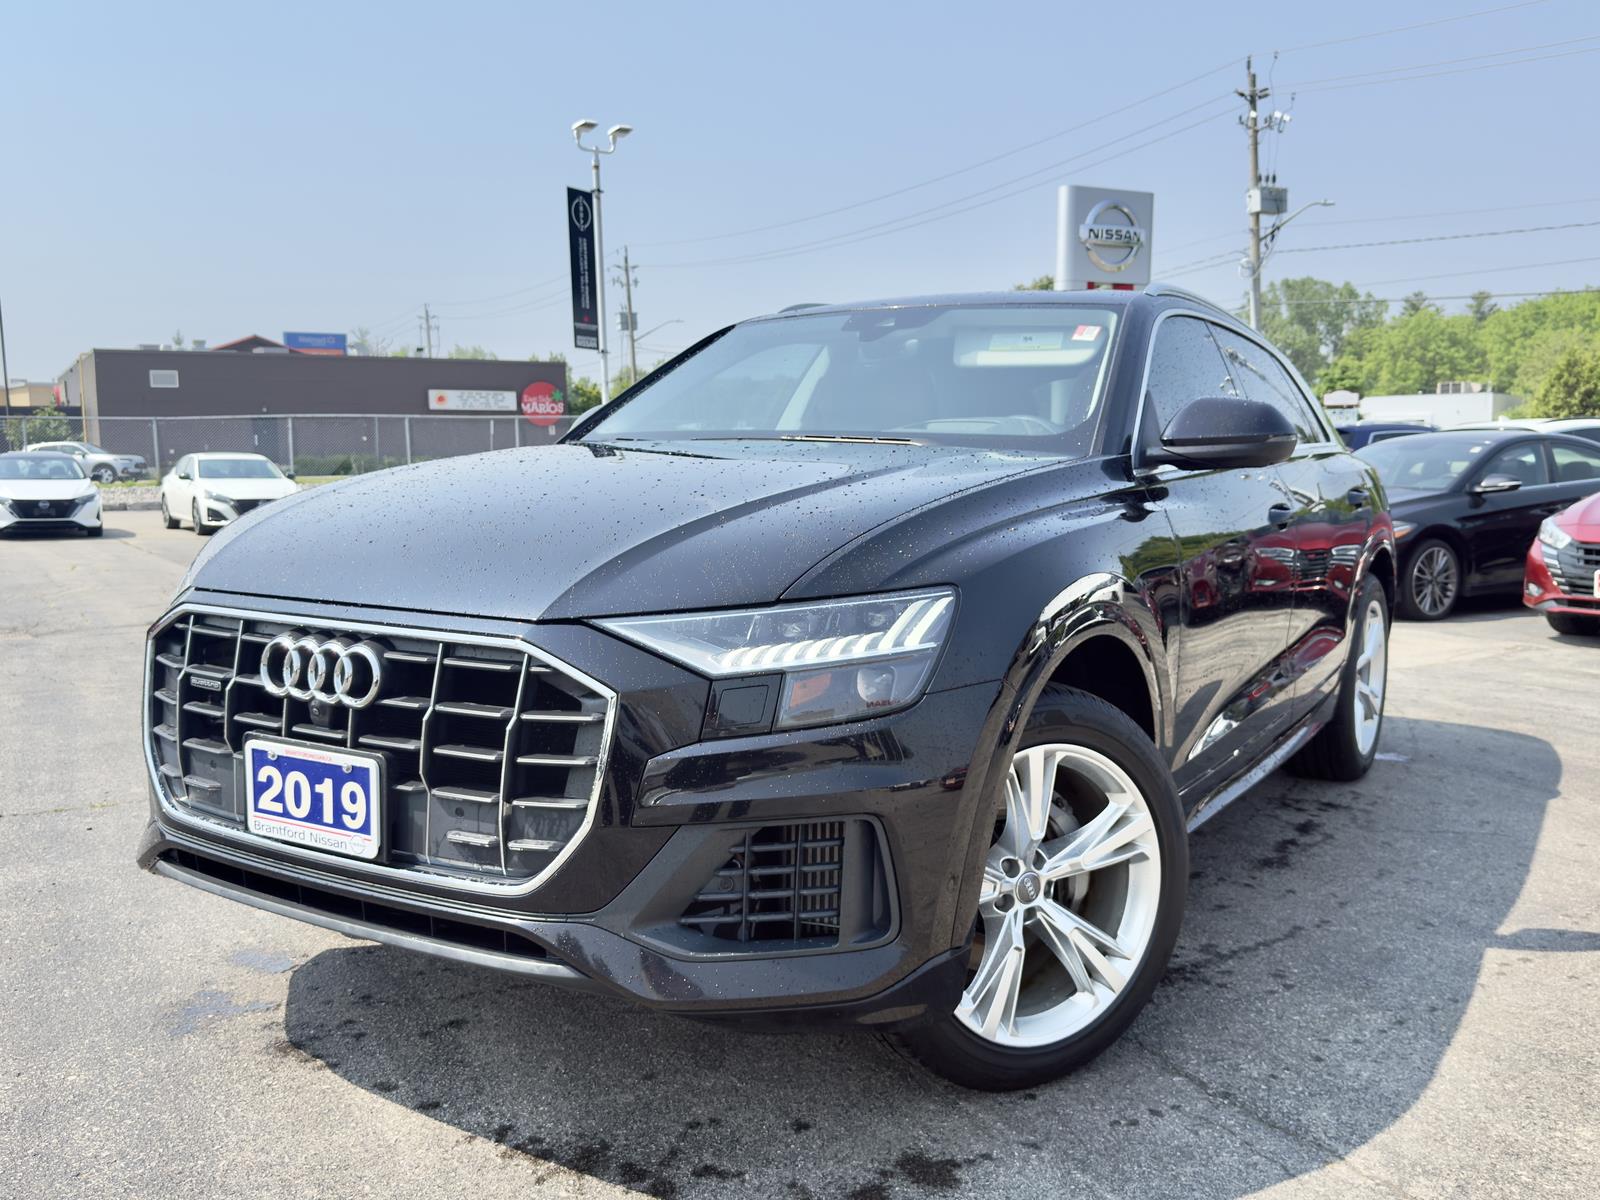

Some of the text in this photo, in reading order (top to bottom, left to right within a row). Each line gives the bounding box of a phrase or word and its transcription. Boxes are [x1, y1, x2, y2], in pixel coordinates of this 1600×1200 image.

[1088, 229, 1140, 242] NISSAN
[257, 765, 367, 830] 2019
[254, 820, 306, 841] Brantford
[310, 832, 347, 849] Nissan
